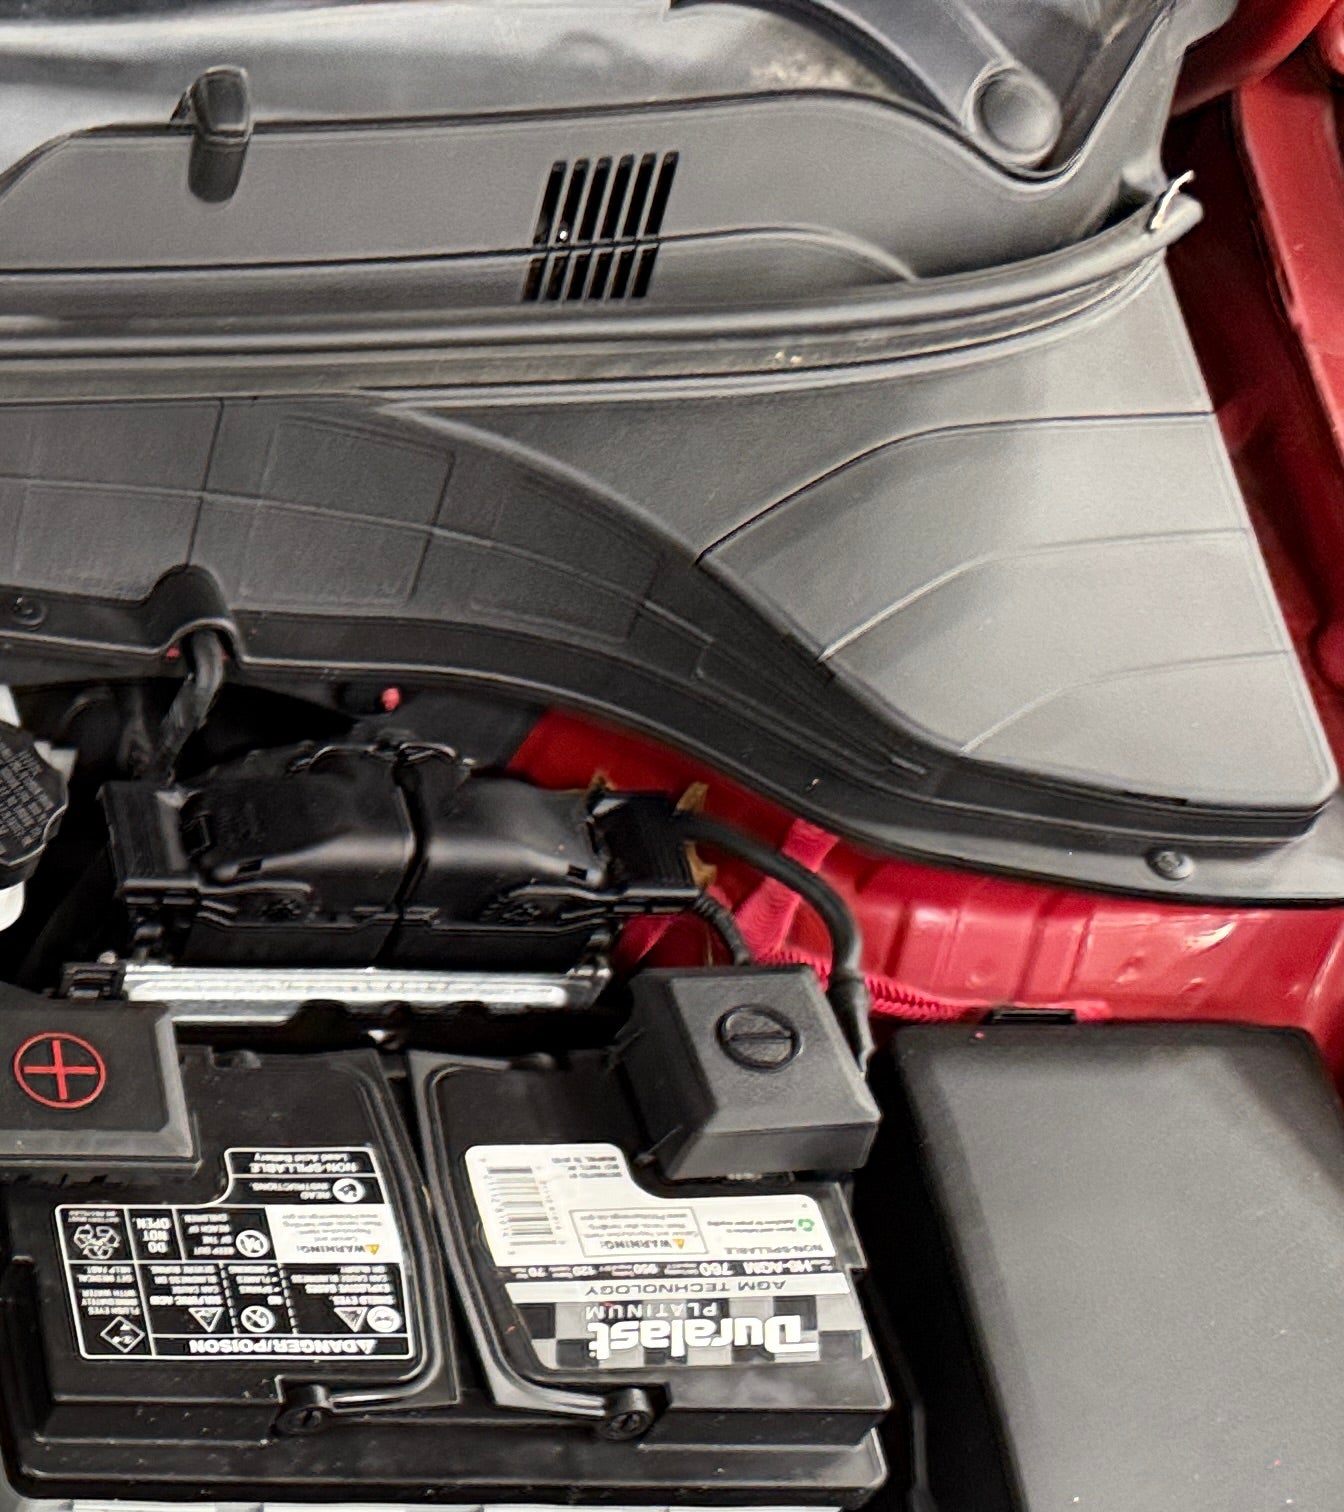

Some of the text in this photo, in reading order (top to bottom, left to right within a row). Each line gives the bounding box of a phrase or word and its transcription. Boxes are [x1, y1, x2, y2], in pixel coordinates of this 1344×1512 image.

[143, 1229, 168, 1240] NOT
[148, 1241, 168, 1253] DO
[584, 1281, 786, 1295] AGM TECHNOLOGY
[585, 1302, 717, 1318] PLATINUM
[587, 1315, 817, 1359] Duralast
[190, 1339, 356, 1353] DANGER/POISON
